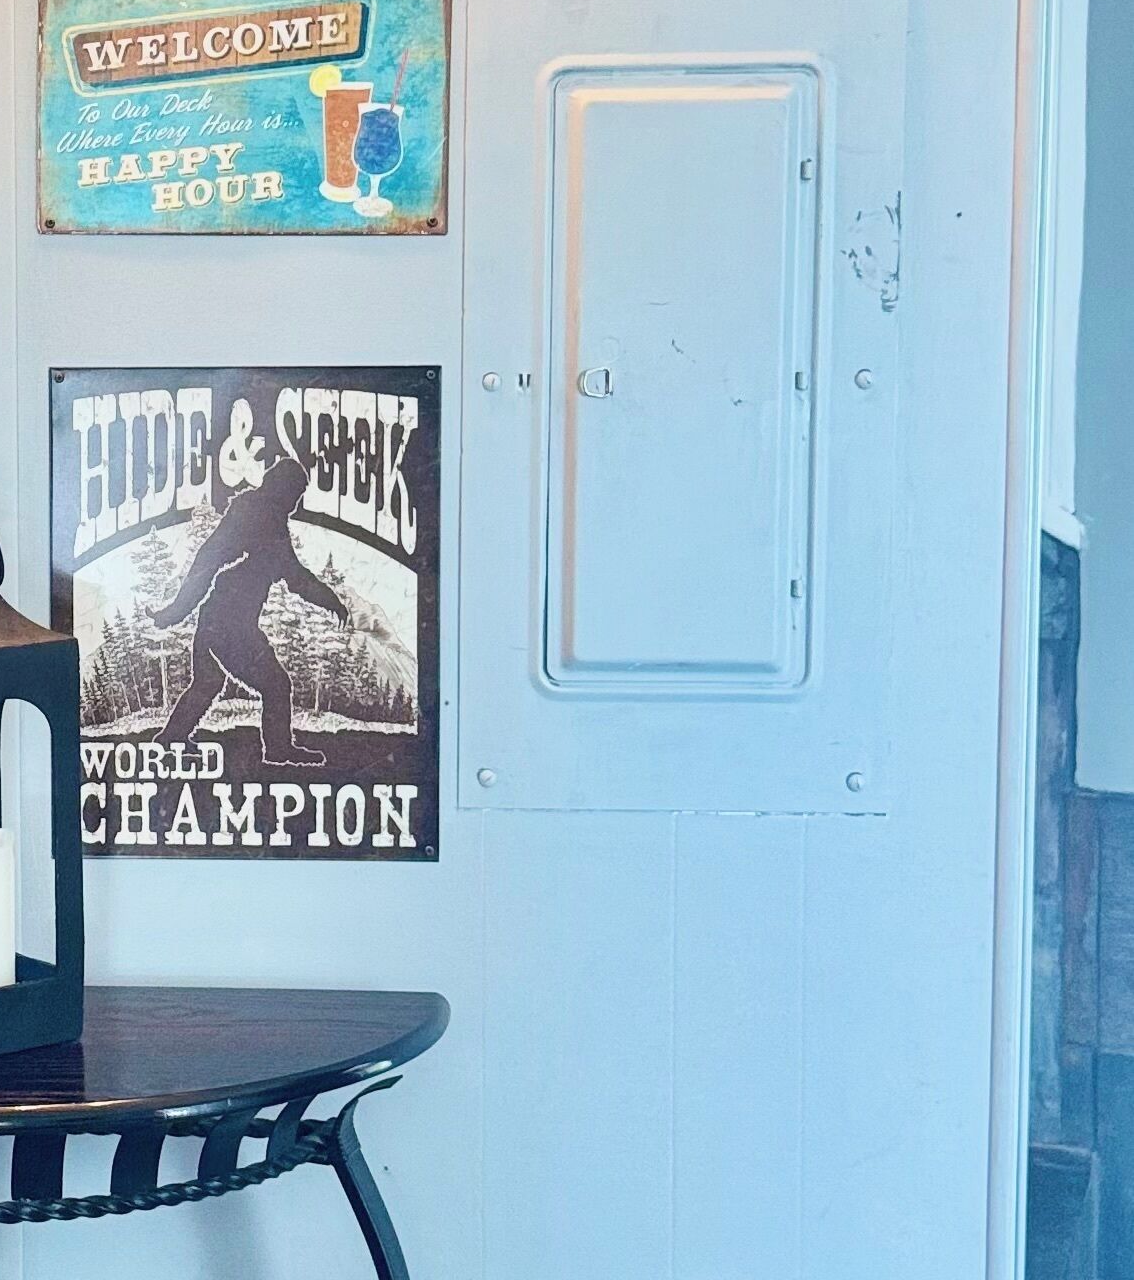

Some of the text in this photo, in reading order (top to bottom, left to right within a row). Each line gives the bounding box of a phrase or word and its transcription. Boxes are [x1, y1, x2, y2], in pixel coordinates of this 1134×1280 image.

[82, 12, 350, 72] WELCOME
[77, 88, 214, 125] To Our Deck
[56, 110, 300, 153] Where Every Hour is...
[77, 142, 244, 187] HAPPY
[151, 171, 284, 212] HOUR
[72, 387, 419, 559] HIDE & SEEK
[80, 742, 224, 780] WORLD
[80, 781, 418, 848] CHAMPION
